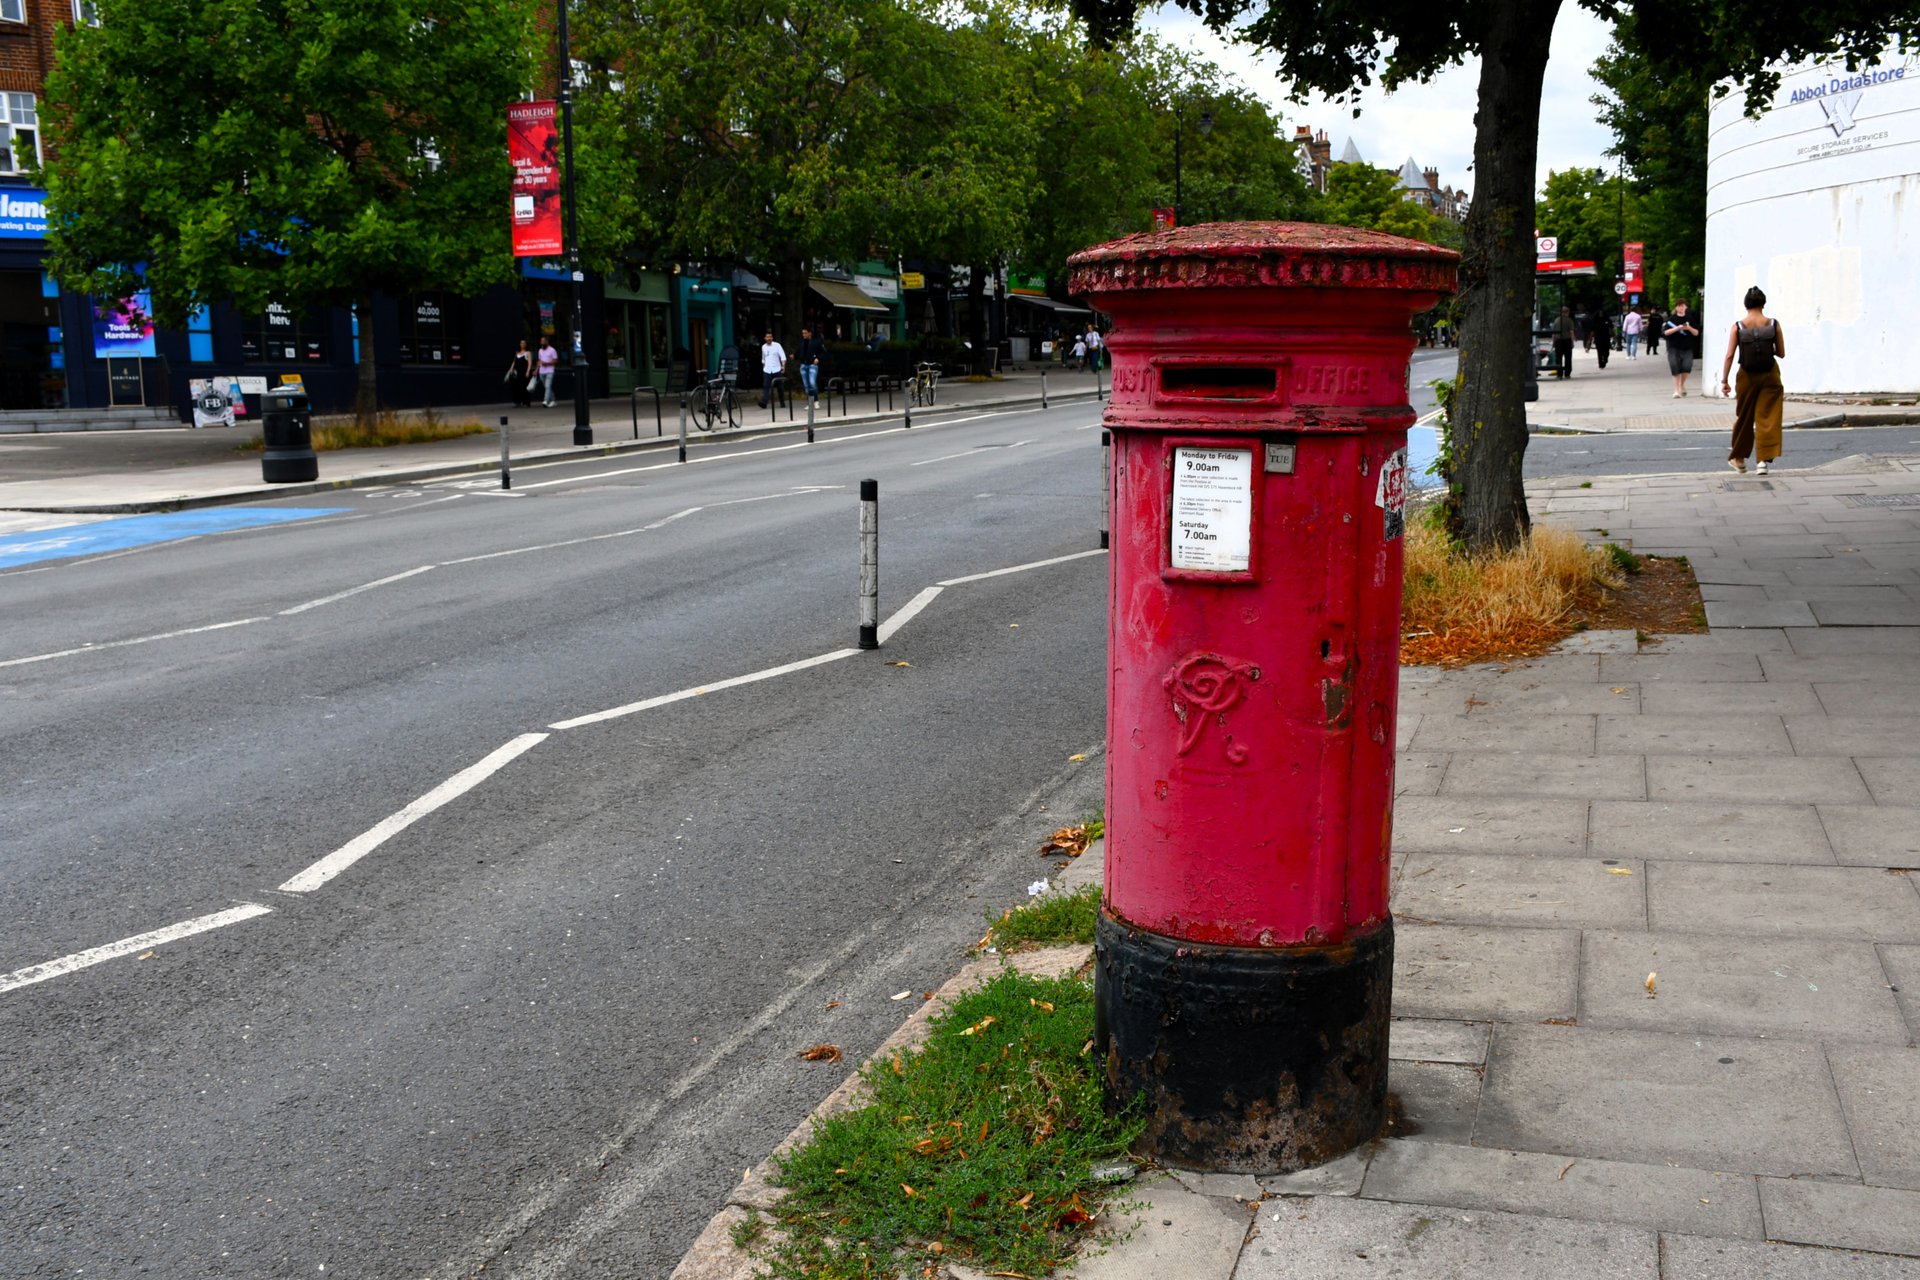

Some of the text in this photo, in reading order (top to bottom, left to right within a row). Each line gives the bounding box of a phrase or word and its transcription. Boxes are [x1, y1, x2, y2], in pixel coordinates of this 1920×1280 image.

[1790, 67, 1905, 103] Abbot Datastore
[510, 107, 554, 118] HADLEIGH
[1797, 131, 1889, 155] SECURE STORAGE SERVICES
[417, 306, 440, 316] 40,000
[1113, 366, 1370, 394] POST OFFICE
[1182, 452, 1207, 460] Monday
[1218, 453, 1239, 461] Friday
[1270, 455, 1290, 464] TUE
[1186, 460, 1220, 472] 9.00am
[1179, 521, 1208, 529] Saturday
[1184, 530, 1217, 541] 7.00am
